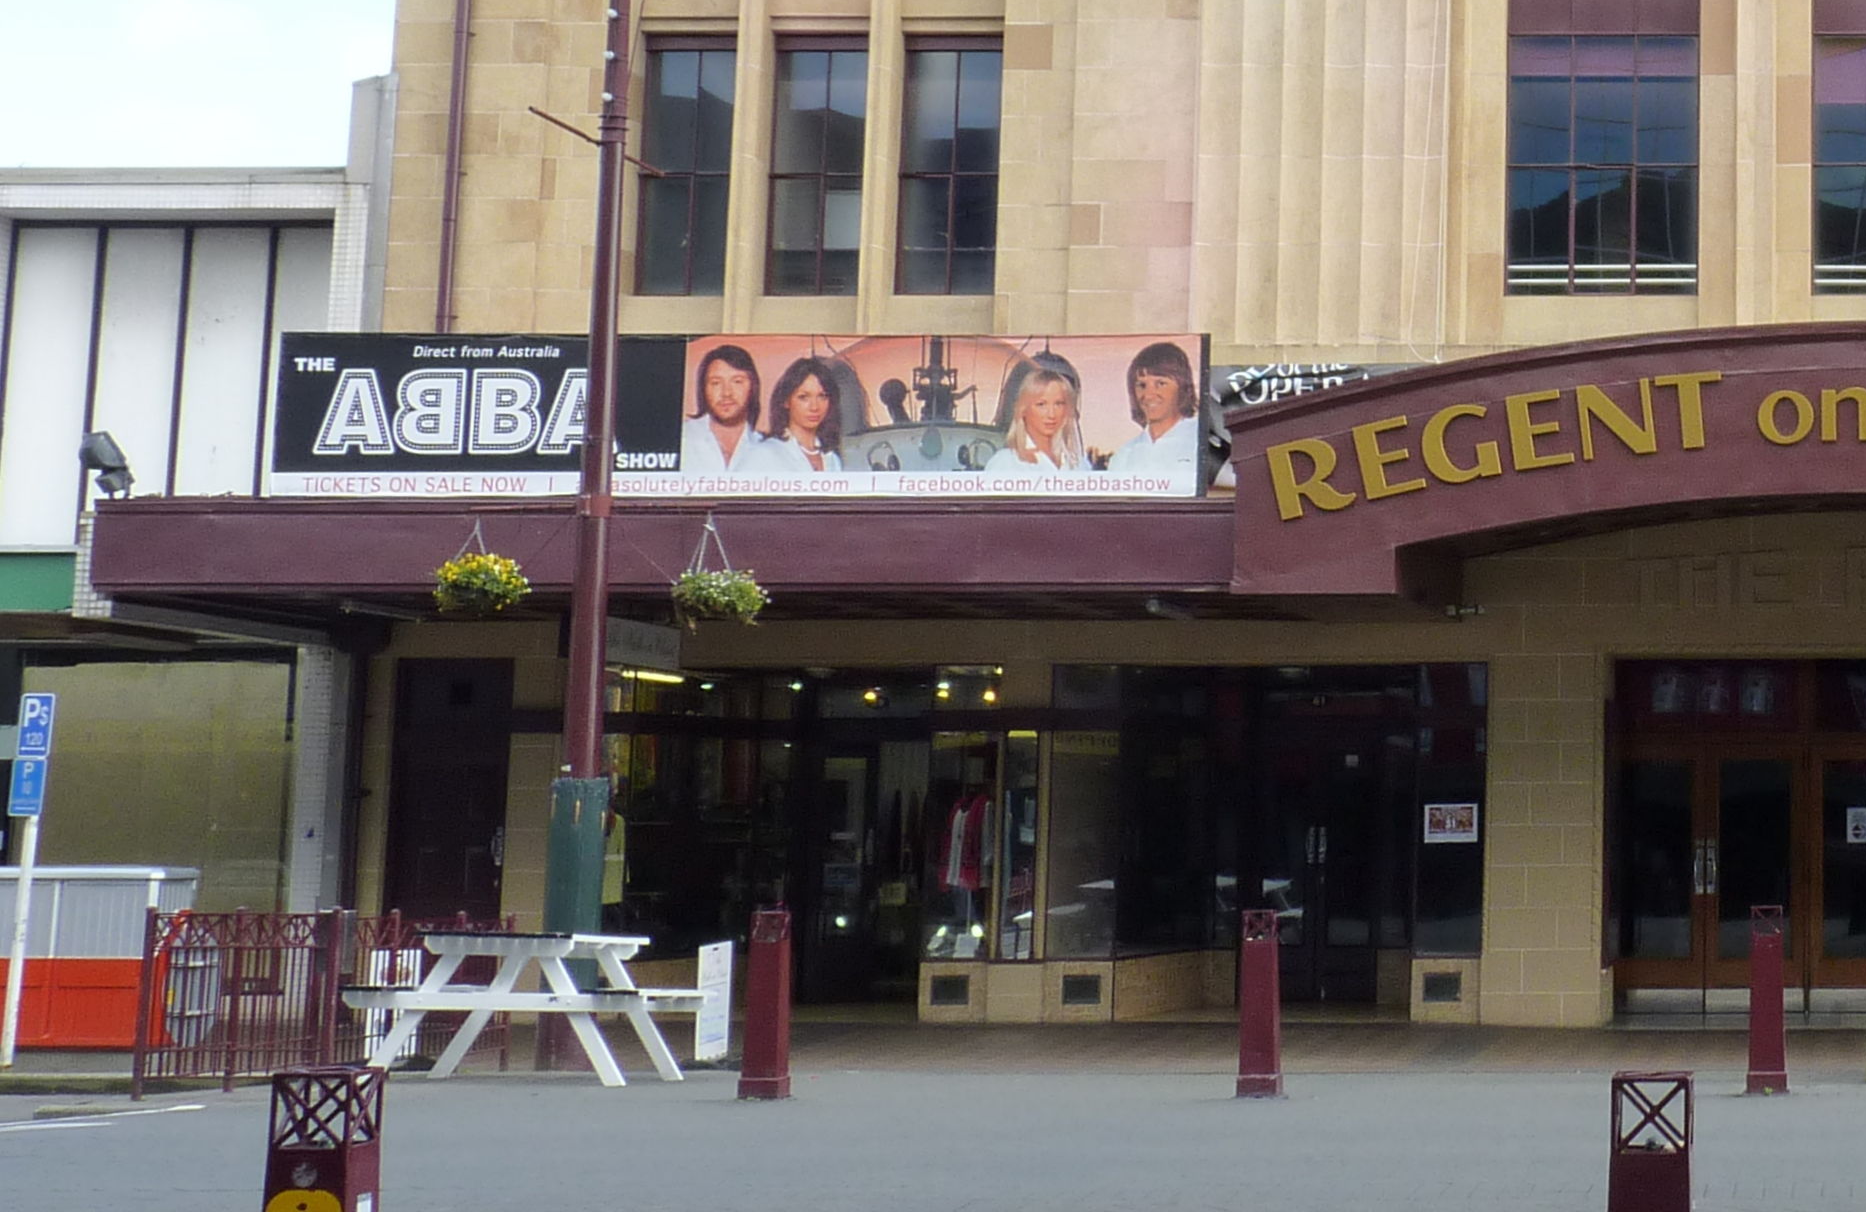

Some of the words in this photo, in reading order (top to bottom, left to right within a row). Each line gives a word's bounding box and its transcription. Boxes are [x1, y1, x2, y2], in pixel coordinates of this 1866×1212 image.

[413, 344, 456, 358] Direct
[461, 344, 493, 358] from
[498, 344, 561, 358] Australia
[294, 357, 335, 372] THE
[312, 368, 618, 456] ABBA
[1265, 371, 1722, 523] REGENT
[615, 452, 677, 470] SHOW
[302, 476, 381, 493] TICKETS
[389, 476, 418, 493] ON
[425, 476, 473, 493] SALE
[478, 476, 527, 493] NOW
[575, 475, 849, 495] aasolutelyfabbaulous.com
[898, 475, 1171, 492] facebook.com/theabbashow
[1626, 548, 1795, 604] THE
